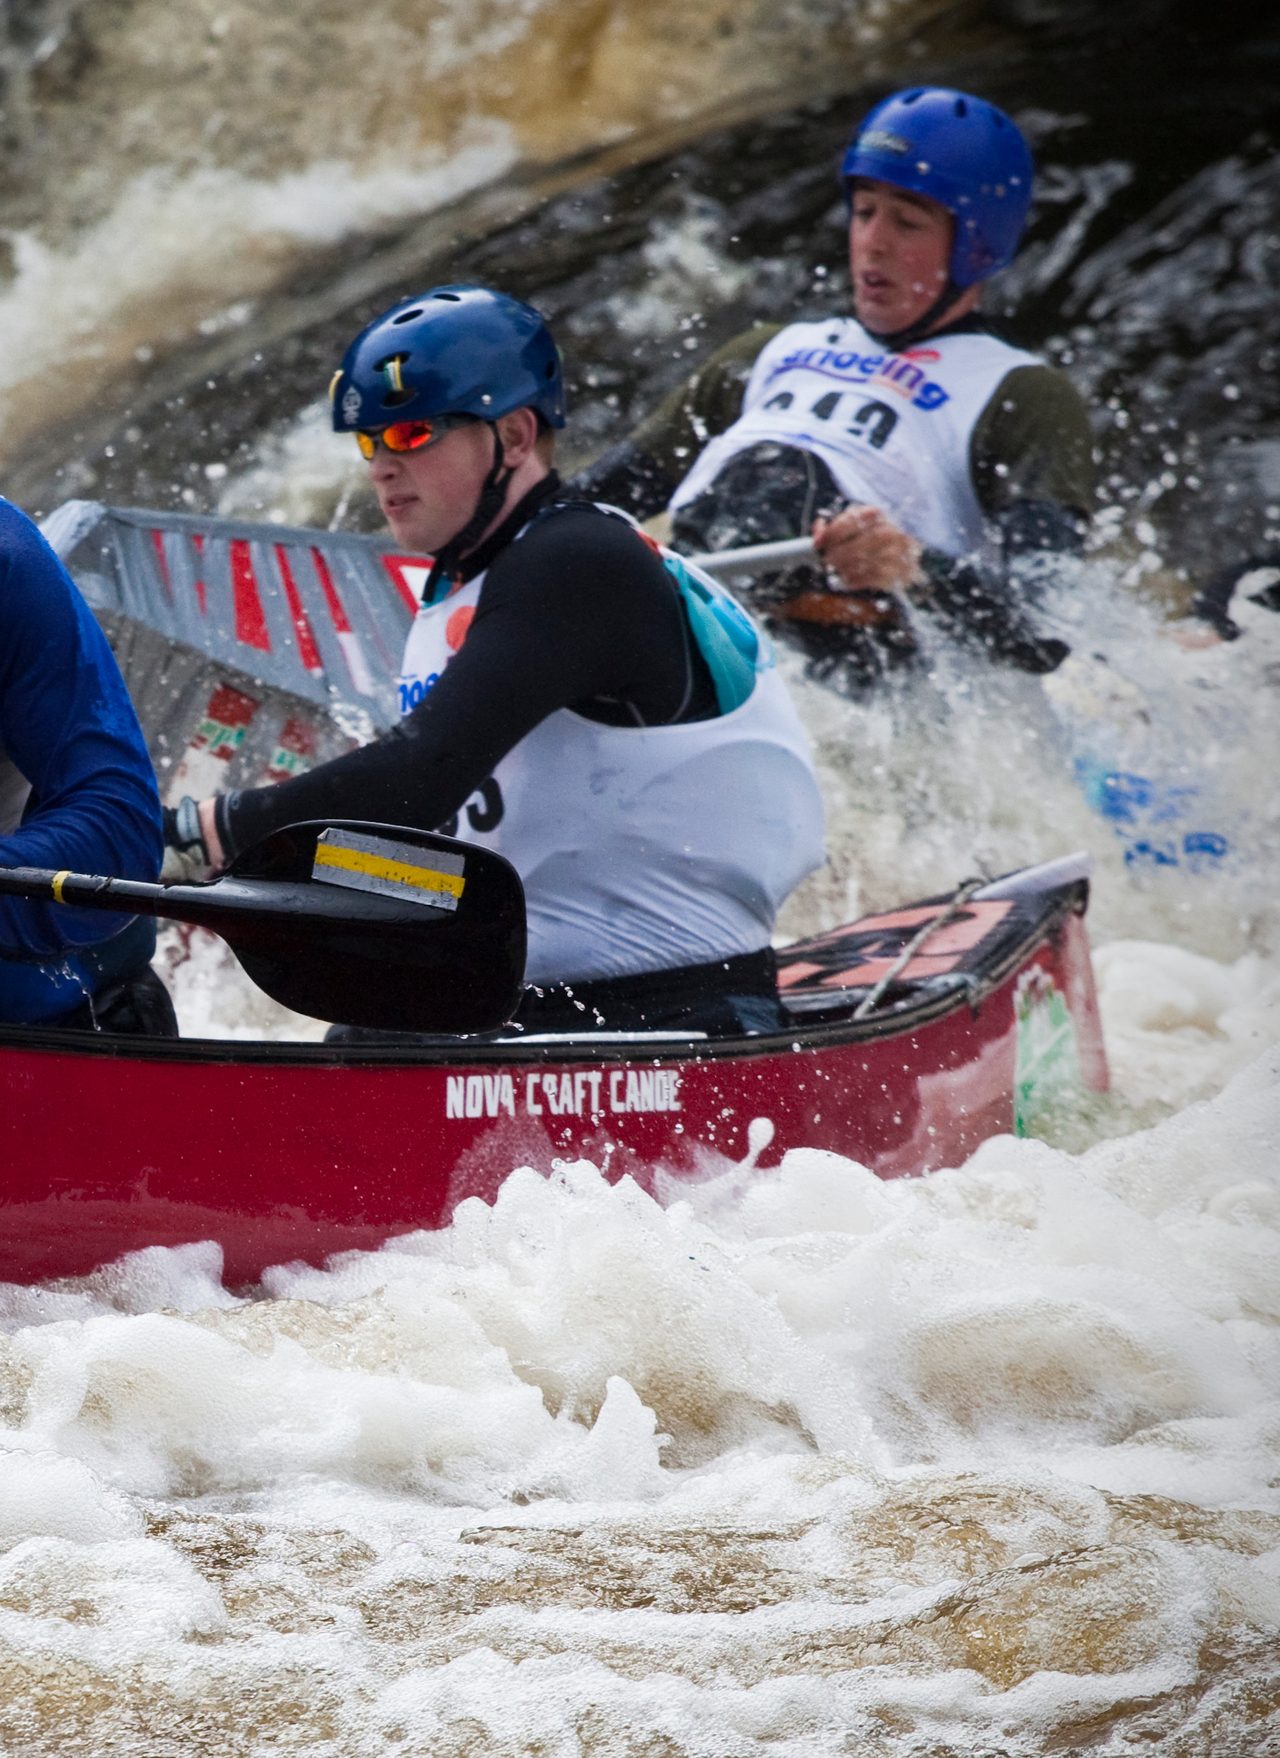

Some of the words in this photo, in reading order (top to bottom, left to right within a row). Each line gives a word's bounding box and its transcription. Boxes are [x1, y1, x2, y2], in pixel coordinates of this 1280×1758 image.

[446, 1075, 516, 1119] NOVA
[526, 1071, 602, 1116] CRAFT
[609, 1069, 682, 1113] CANOE
